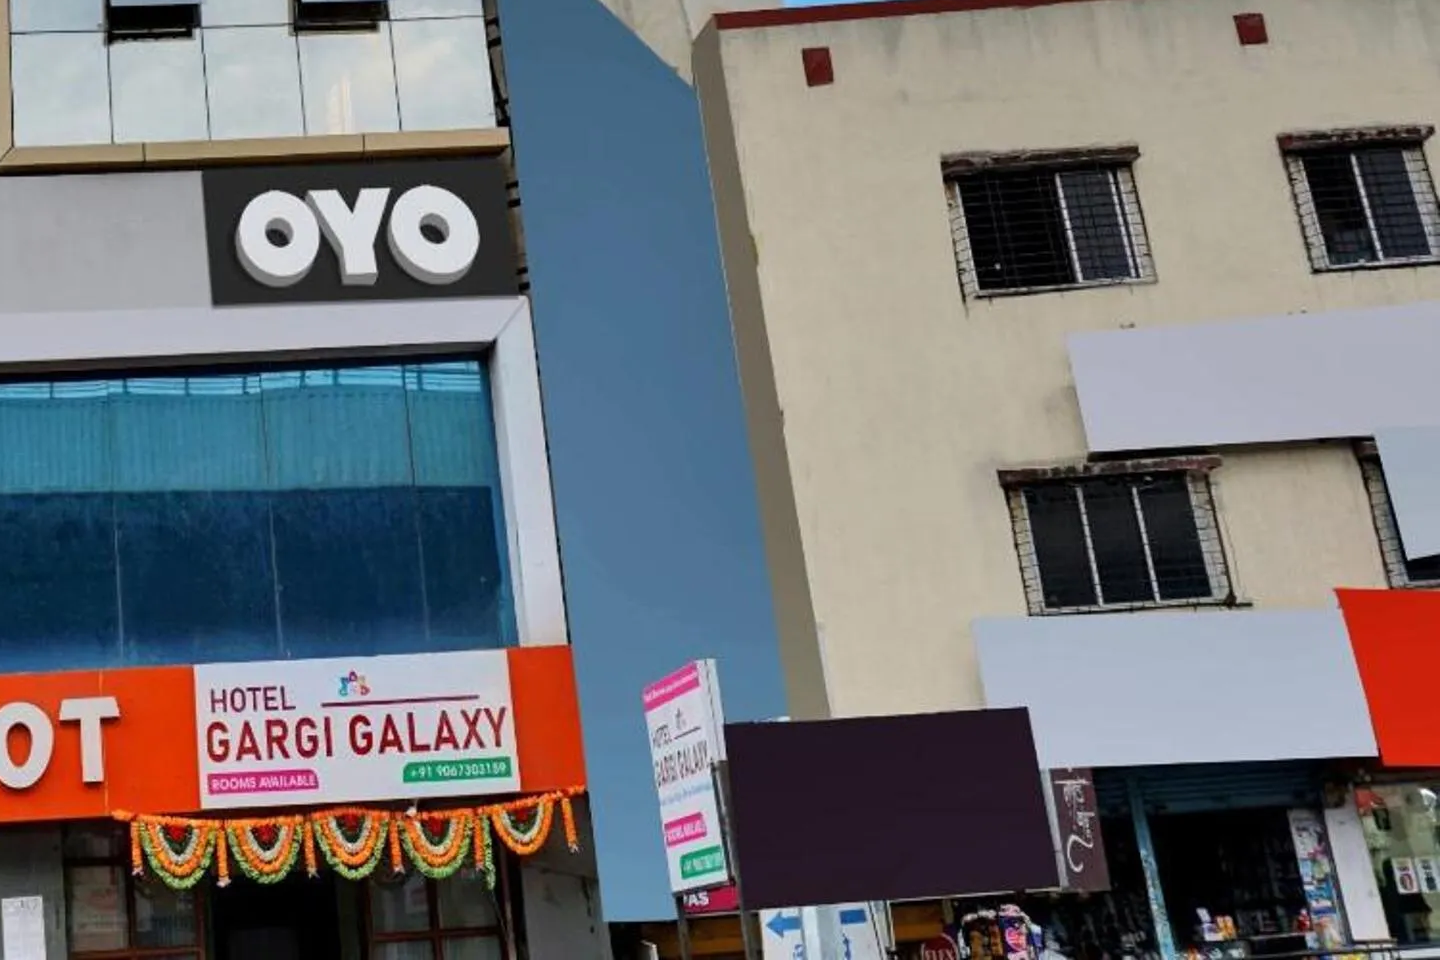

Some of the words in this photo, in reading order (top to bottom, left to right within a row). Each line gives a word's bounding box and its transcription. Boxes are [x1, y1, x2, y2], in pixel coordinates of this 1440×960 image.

[235, 184, 480, 288] OYO
[210, 685, 297, 714] HOTEL
[206, 715, 334, 763] GARGI
[348, 705, 507, 756] GALAXY
[211, 776, 257, 791] ROOMS
[258, 774, 317, 789] AVAILABLE
